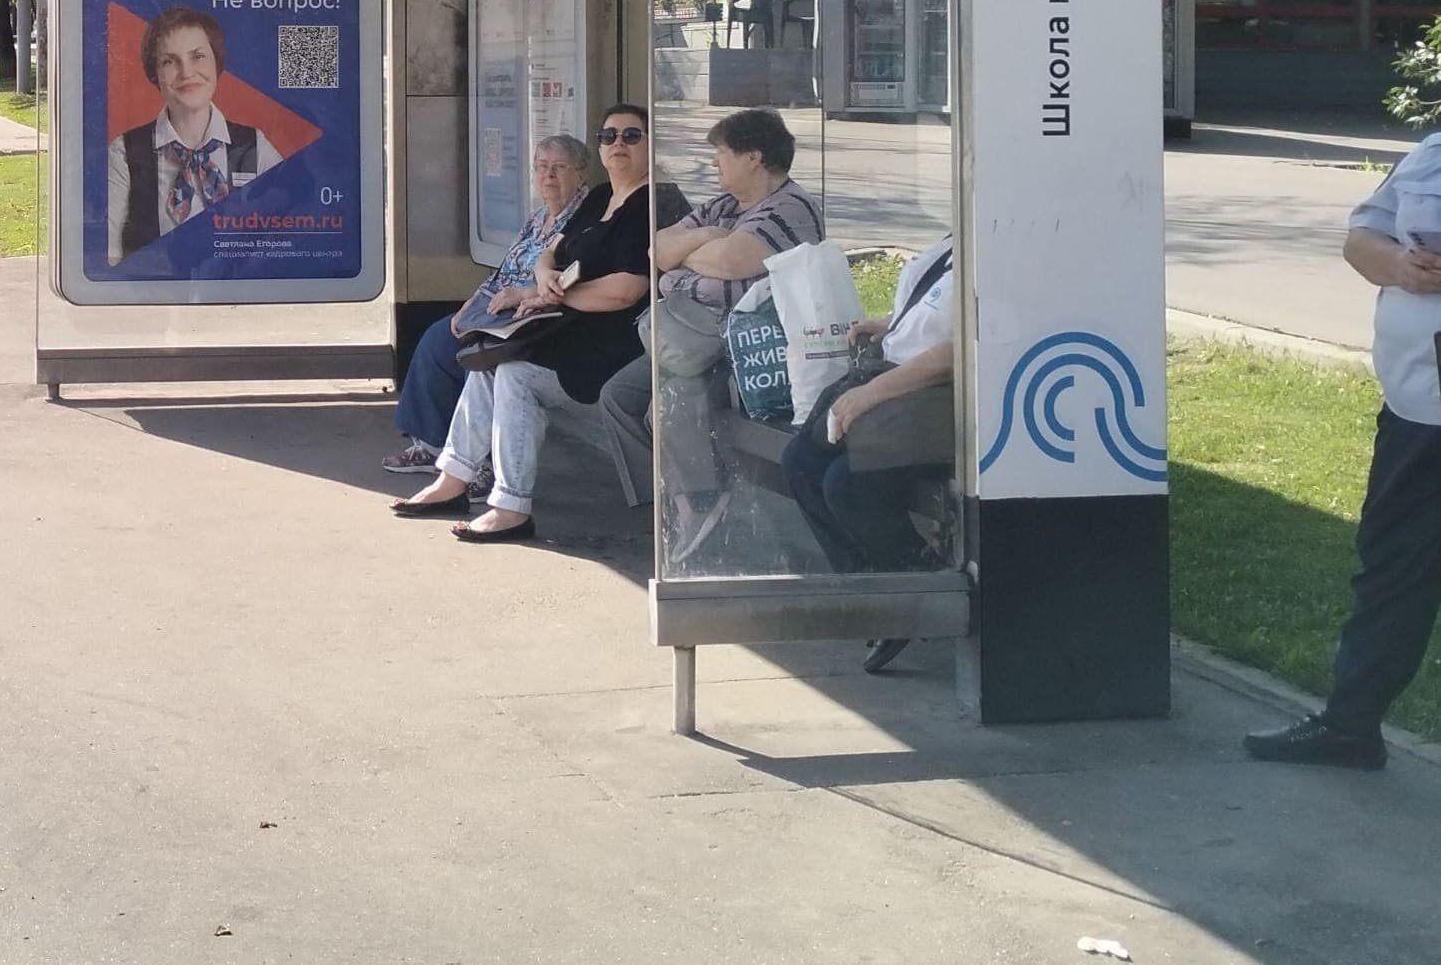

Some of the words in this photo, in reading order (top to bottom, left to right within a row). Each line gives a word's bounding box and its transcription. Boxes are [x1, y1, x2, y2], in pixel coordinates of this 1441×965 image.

[1042, 15, 1071, 137] Школа
[320, 186, 344, 205] 0+
[213, 212, 343, 230] trudvsem.ru
[213, 240, 255, 248] Светлана
[256, 240, 292, 249] Егорова
[742, 346, 787, 368] ЖИВ
[744, 370, 791, 391] КОЛ
